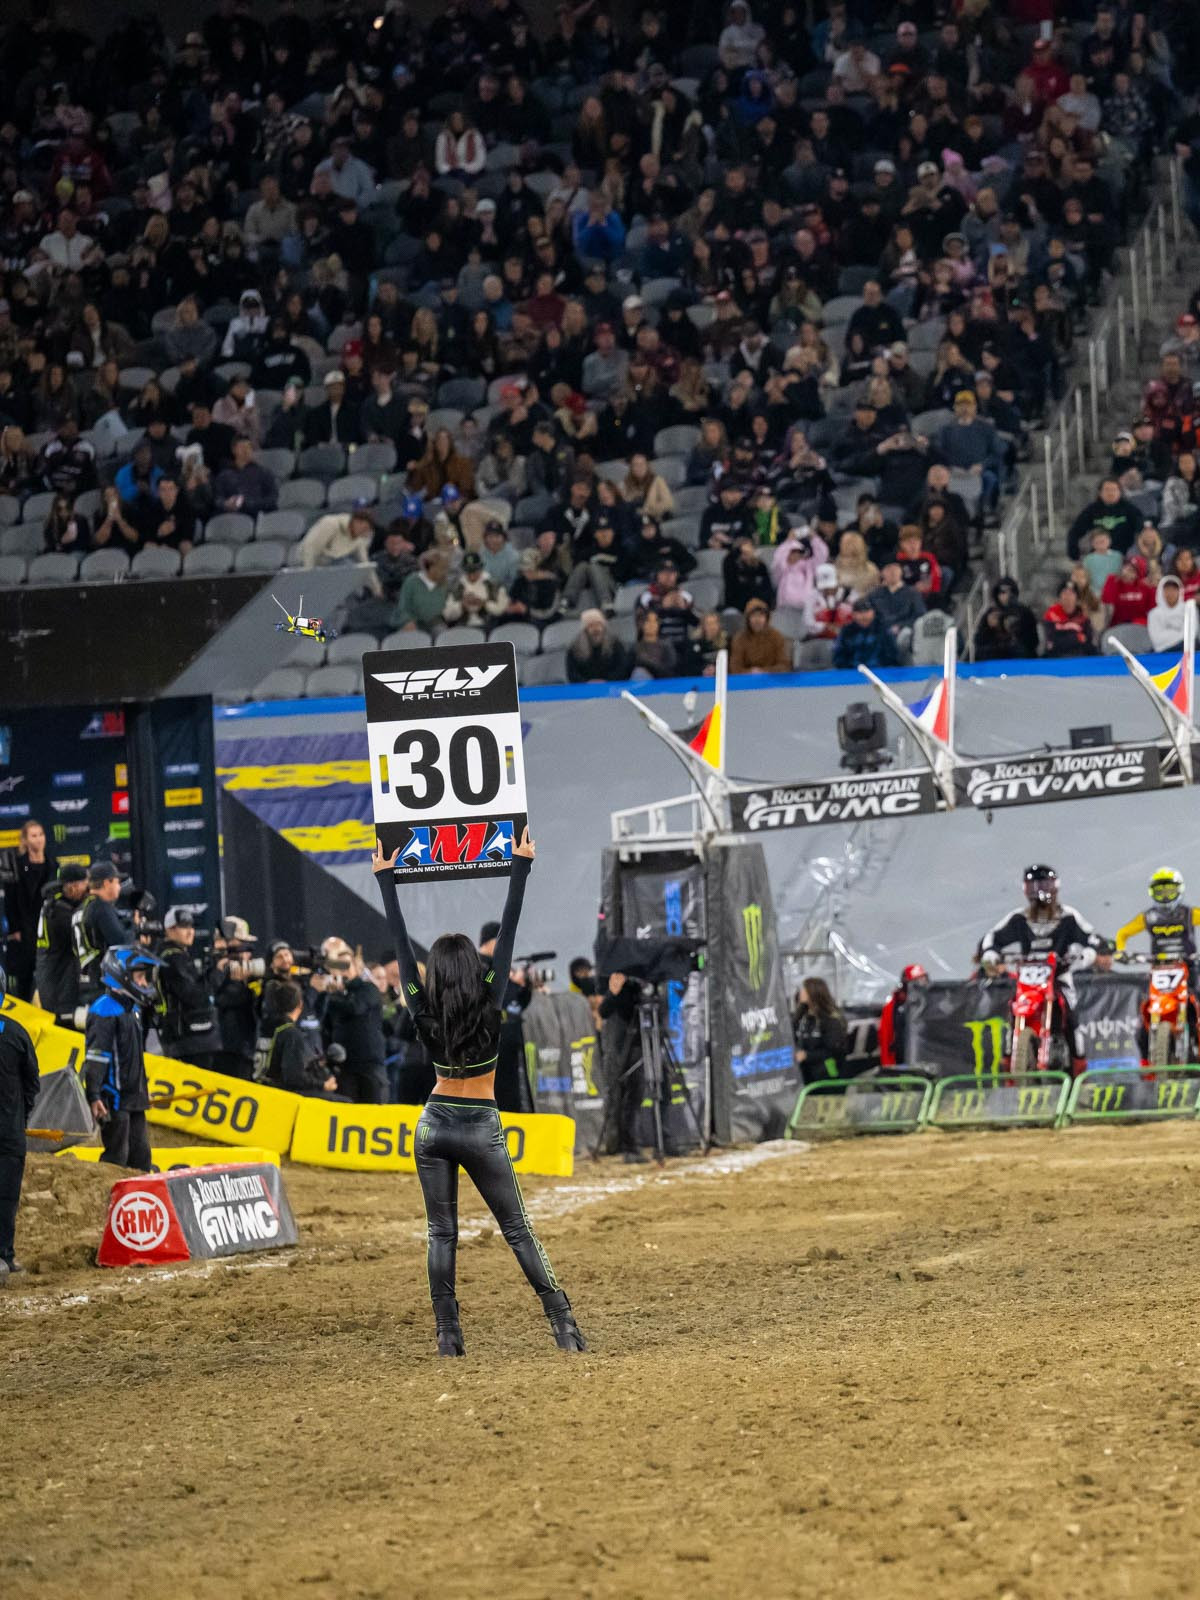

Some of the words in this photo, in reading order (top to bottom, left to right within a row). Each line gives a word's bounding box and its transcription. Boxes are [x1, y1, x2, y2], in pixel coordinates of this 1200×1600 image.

[380, 664, 508, 694] FLY
[402, 689, 482, 701] RACING
[393, 724, 501, 809] 30
[993, 761, 1048, 780] ROCKY
[1052, 751, 1144, 772] MOUNTAIN
[771, 786, 826, 805] ROCKY
[828, 777, 920, 799] MOUNTAIN
[395, 820, 514, 867] AMA
[424, 863, 477, 872] MOTORCYCLIST
[478, 860, 512, 868] ASSOCIAT
[196, 1177, 226, 1205] ROCKY
[220, 1174, 265, 1202] MOUNTAIN
[122, 1209, 157, 1233] RM
